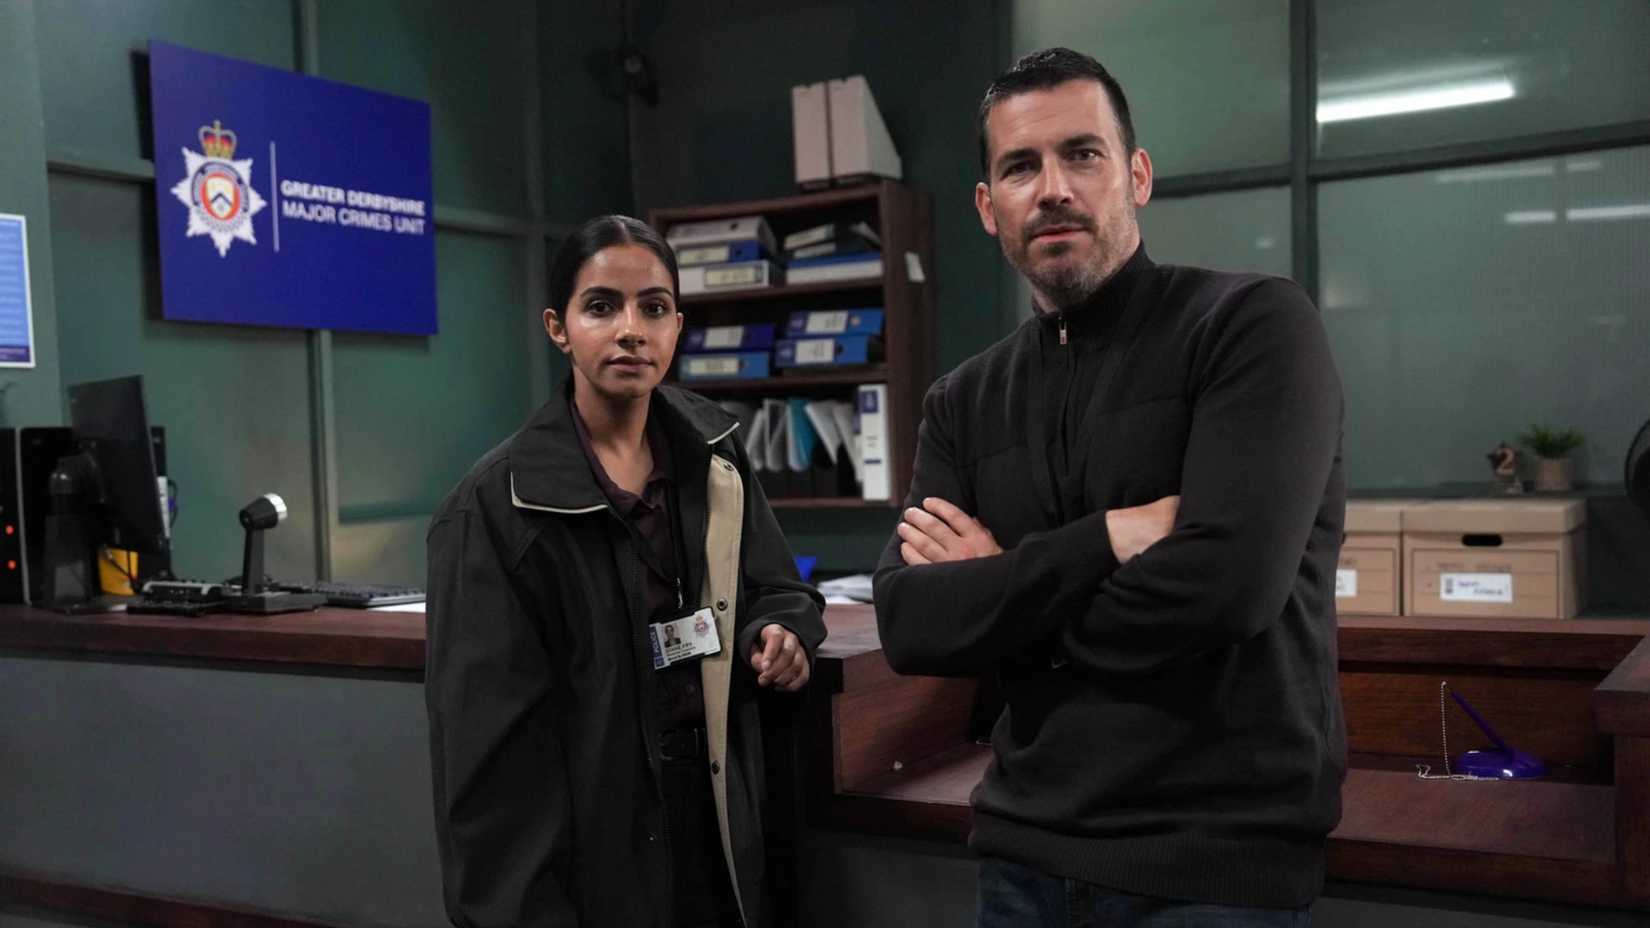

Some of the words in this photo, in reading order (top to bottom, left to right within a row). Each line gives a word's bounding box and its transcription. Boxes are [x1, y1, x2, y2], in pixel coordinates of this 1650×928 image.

[281, 180, 345, 204] GREATER
[347, 190, 425, 216] DERBYSHIRE
[282, 201, 336, 224] MAJOR
[338, 207, 392, 231] CRIMES
[393, 215, 425, 234] UNIT
